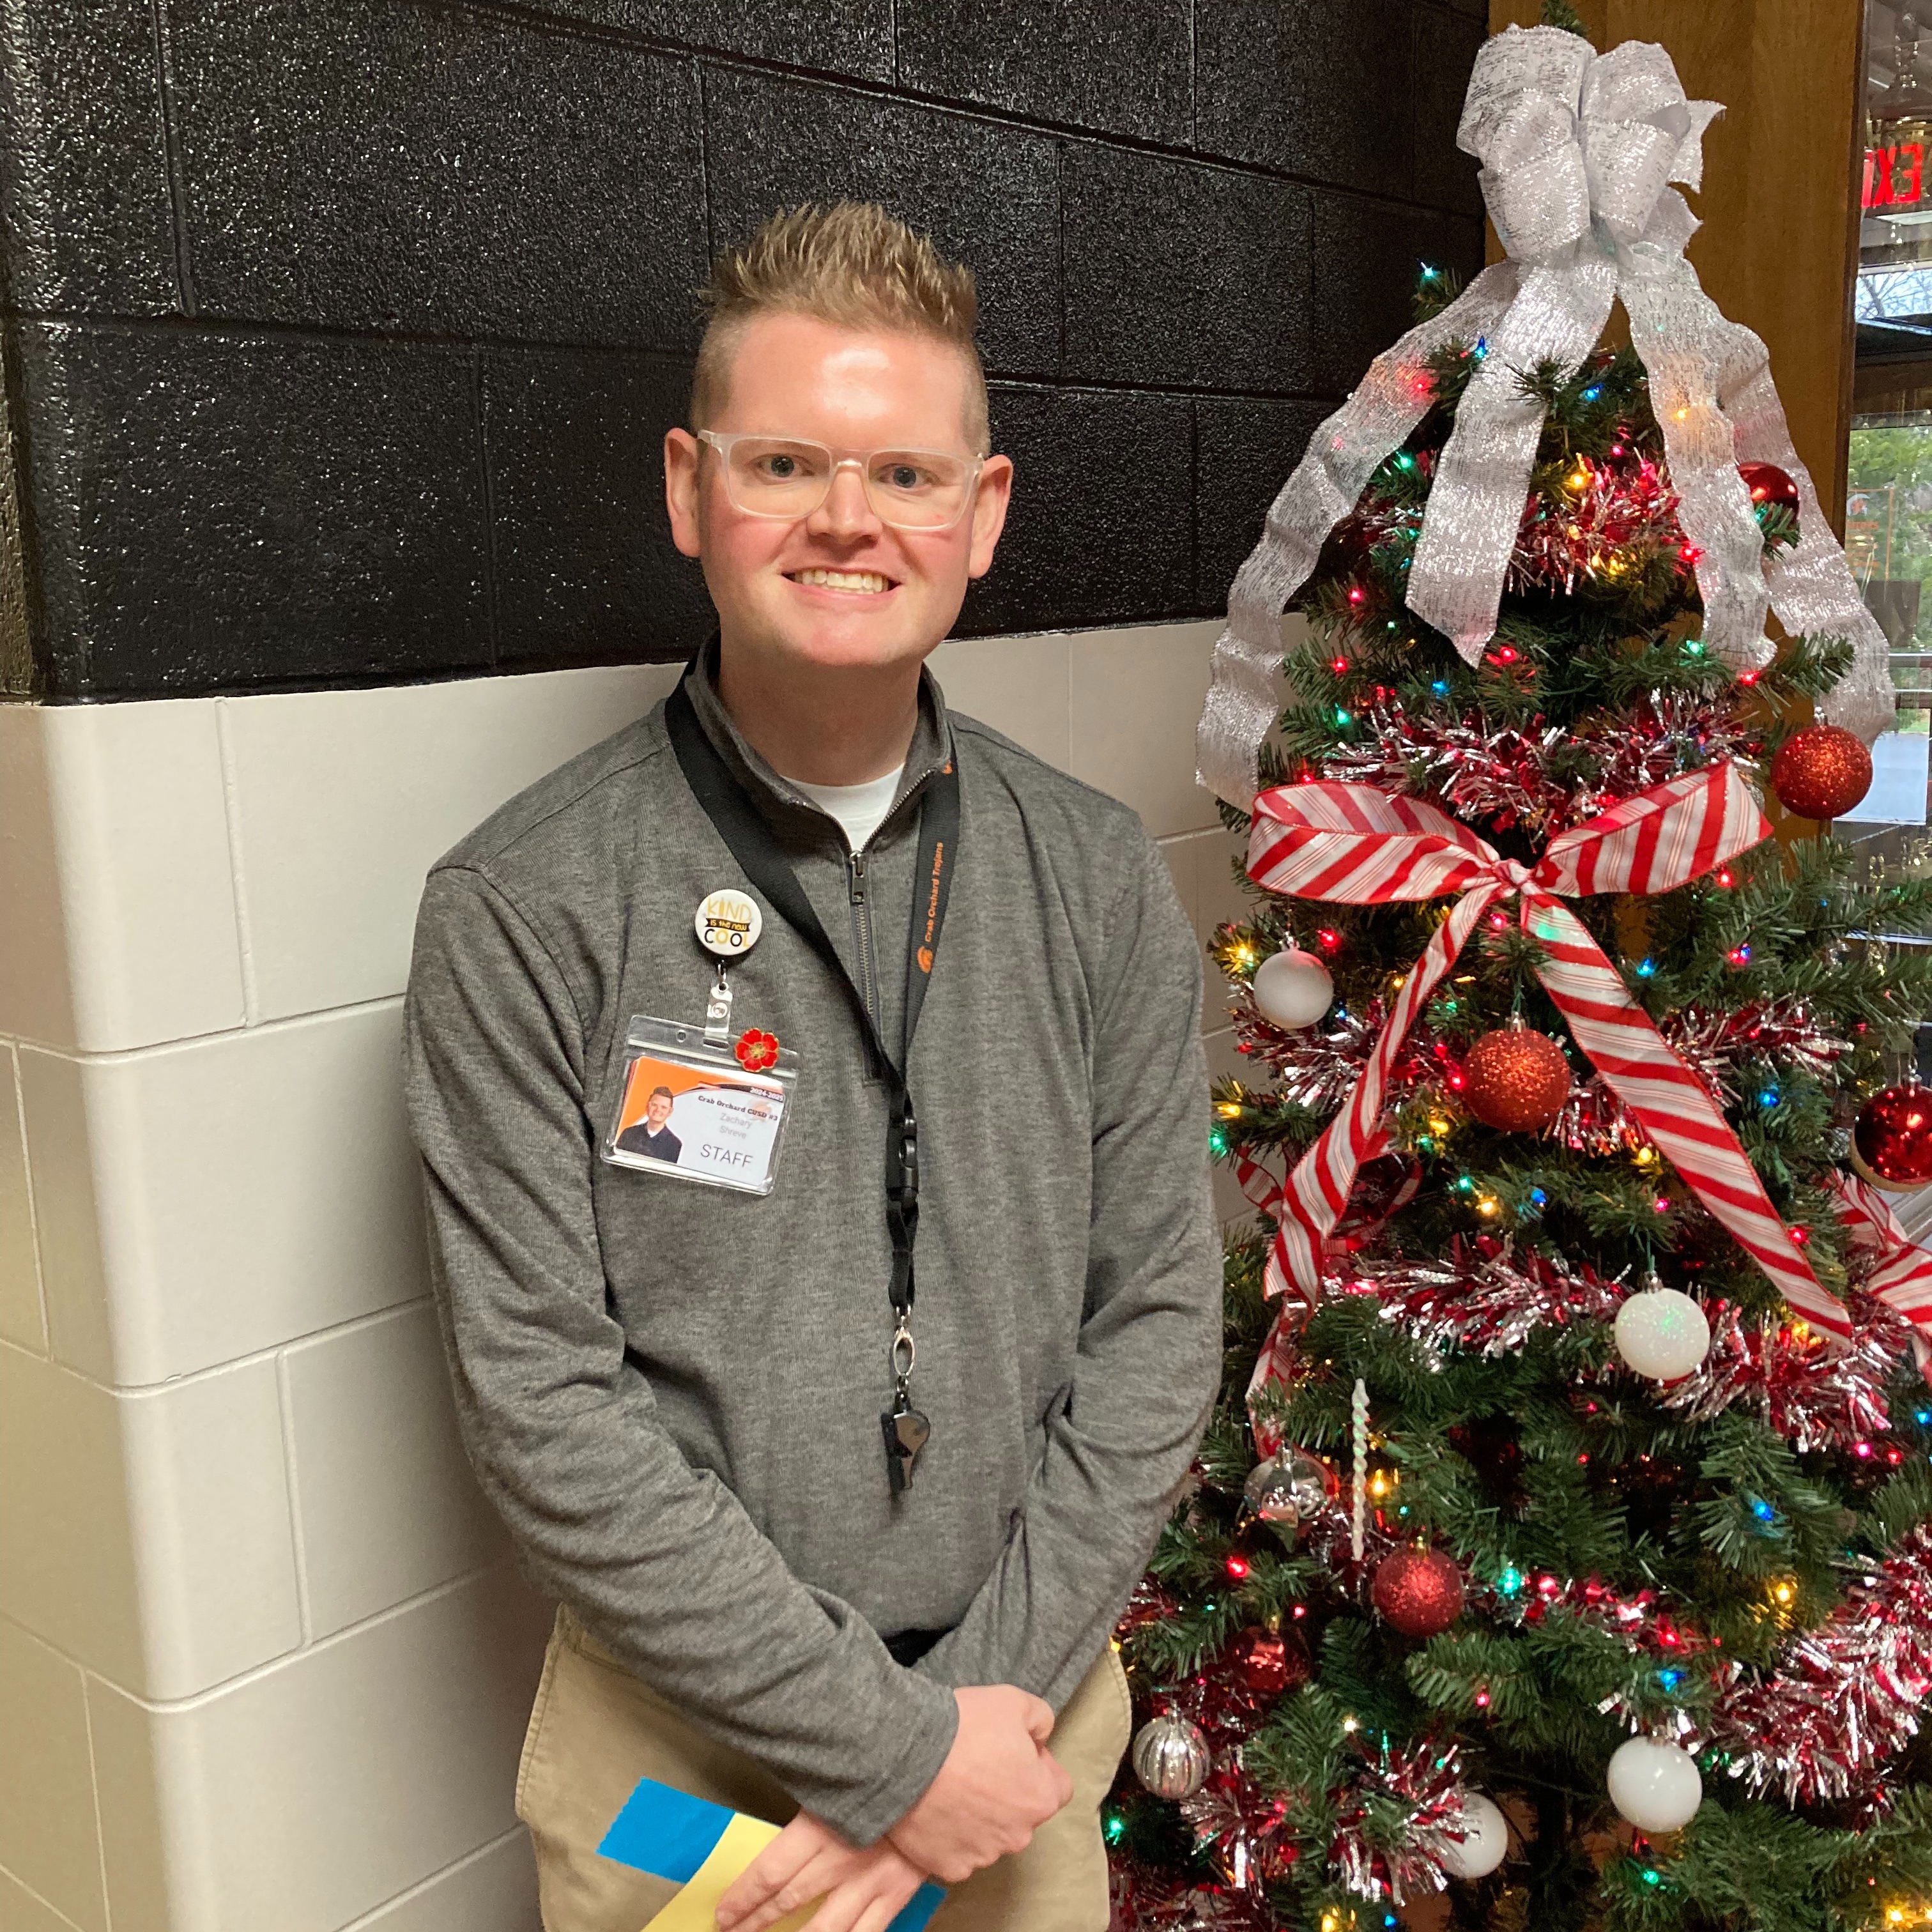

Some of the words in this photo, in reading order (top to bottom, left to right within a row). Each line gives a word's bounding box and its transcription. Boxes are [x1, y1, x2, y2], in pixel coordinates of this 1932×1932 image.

[932, 841, 944, 876] Trojans
[707, 897, 751, 921] KIND
[928, 878, 940, 918] Orchard
[705, 928, 751, 948] COOL
[925, 919, 935, 942] Crab
[698, 1095, 715, 1105] Crab
[716, 1100, 746, 1113] Orchard
[747, 1108, 767, 1118] CUSD
[719, 1125, 747, 1139] Shreve
[720, 1113, 752, 1129] Zachary
[700, 1144, 754, 1167] STAFF
